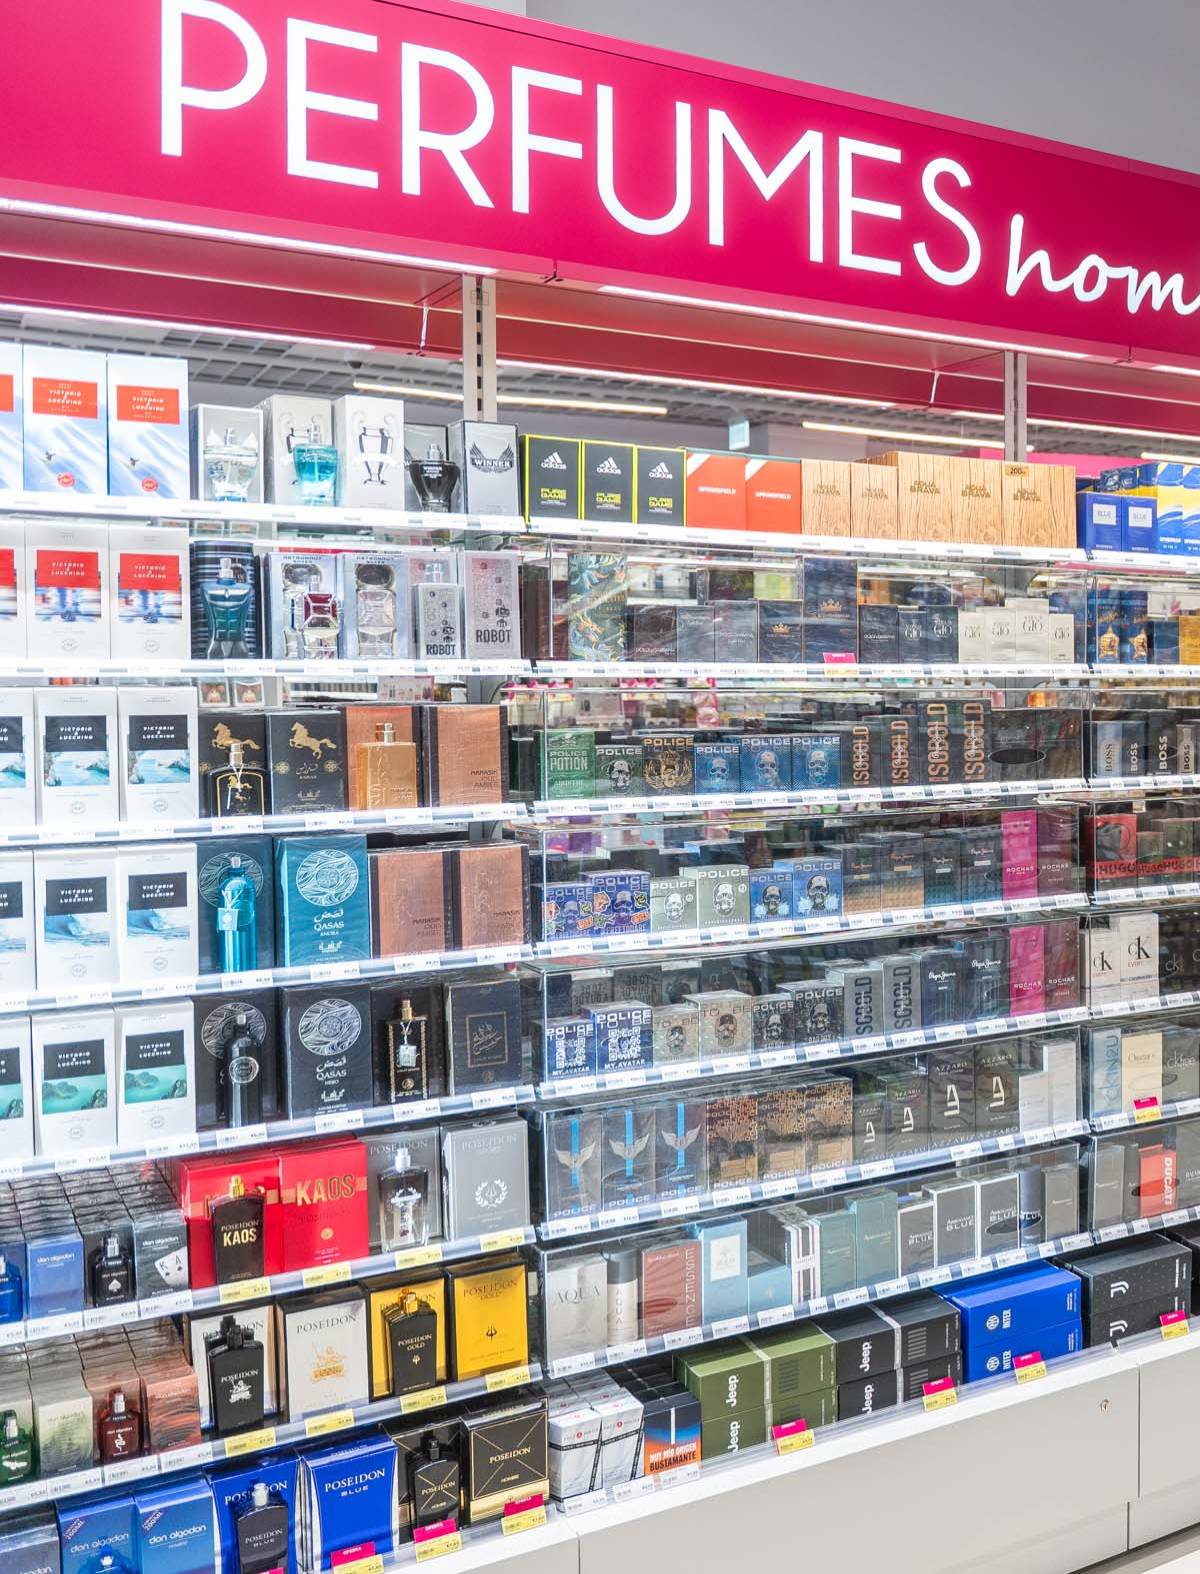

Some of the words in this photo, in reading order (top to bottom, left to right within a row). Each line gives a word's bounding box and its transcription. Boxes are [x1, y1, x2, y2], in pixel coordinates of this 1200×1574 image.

[160, 0, 982, 287] PERFUMES
[473, 458, 512, 468] WINNER
[541, 462, 567, 470] adidas
[597, 467, 622, 475] adidas
[475, 629, 511, 643] ROBOT
[426, 644, 456, 655] ROBOT
[643, 737, 694, 747] POLICE
[741, 738, 791, 746] POLICE
[793, 736, 840, 746] POLICE
[596, 748, 643, 756] POLICE
[696, 746, 739, 755] POLICE
[1159, 736, 1167, 769] BOSS
[1130, 743, 1138, 772] BOSS
[550, 757, 588, 771] POTION
[796, 862, 841, 872] POLICE
[698, 869, 748, 879] POLICE
[751, 874, 792, 882] POLICE
[594, 875, 649, 886] POLICE
[652, 880, 696, 889] POLICE
[547, 887, 593, 897] POLICE
[313, 921, 345, 932] QASAS
[1128, 935, 1151, 960] ck
[1093, 951, 1112, 971] ck
[1165, 952, 1179, 971] ck
[1014, 981, 1042, 989] ROCHAS
[796, 988, 843, 1000] POLICE
[753, 1001, 794, 1012] POLICE
[597, 1009, 651, 1023] POLICE
[547, 1024, 594, 1036] POLICE
[980, 1055, 1013, 1064] AZZARO
[936, 1062, 968, 1072] AZZARO
[316, 1068, 347, 1080] QASAS
[370, 1139, 429, 1154] POSEIDON
[461, 1134, 517, 1149] POSEIDON
[812, 1159, 848, 1169] POLICE
[763, 1169, 801, 1179] POLICE
[714, 1178, 751, 1189] POLICE
[1164, 1157, 1175, 1205] DUCATI
[296, 1174, 355, 1206] KAOS
[554, 1205, 595, 1217] POLICE
[989, 1211, 1017, 1222] BLUE
[221, 1219, 259, 1231] POSEIDON
[946, 1220, 975, 1232] BLUE
[223, 1227, 257, 1247] KAOS
[908, 1235, 934, 1245] BLUE
[159, 1261, 168, 1271] K
[175, 1255, 182, 1266] A
[463, 1280, 518, 1297] POSEIDON
[556, 1286, 601, 1305] AQUA
[296, 1313, 357, 1334] POSEIDON
[1002, 1309, 1011, 1329] INTER
[398, 1333, 433, 1347] POSEIDON
[407, 1342, 427, 1351] GOLD
[860, 1341, 871, 1372] Jeep
[1002, 1350, 1011, 1370] INTER
[220, 1368, 259, 1383] POSEIDON
[726, 1375, 738, 1407] Jeep
[862, 1384, 874, 1414] Jeep
[728, 1421, 738, 1452] Jeep
[489, 1446, 532, 1464] POSEIDON
[649, 1451, 697, 1472] BUSTAMANTE
[324, 1467, 386, 1493] POSEIDON
[340, 1485, 369, 1497] BLUE
[421, 1480, 456, 1496] POSEIDON
[149, 1532, 167, 1545] don
[244, 1527, 284, 1545] POSEIDON
[70, 1542, 90, 1553] don
